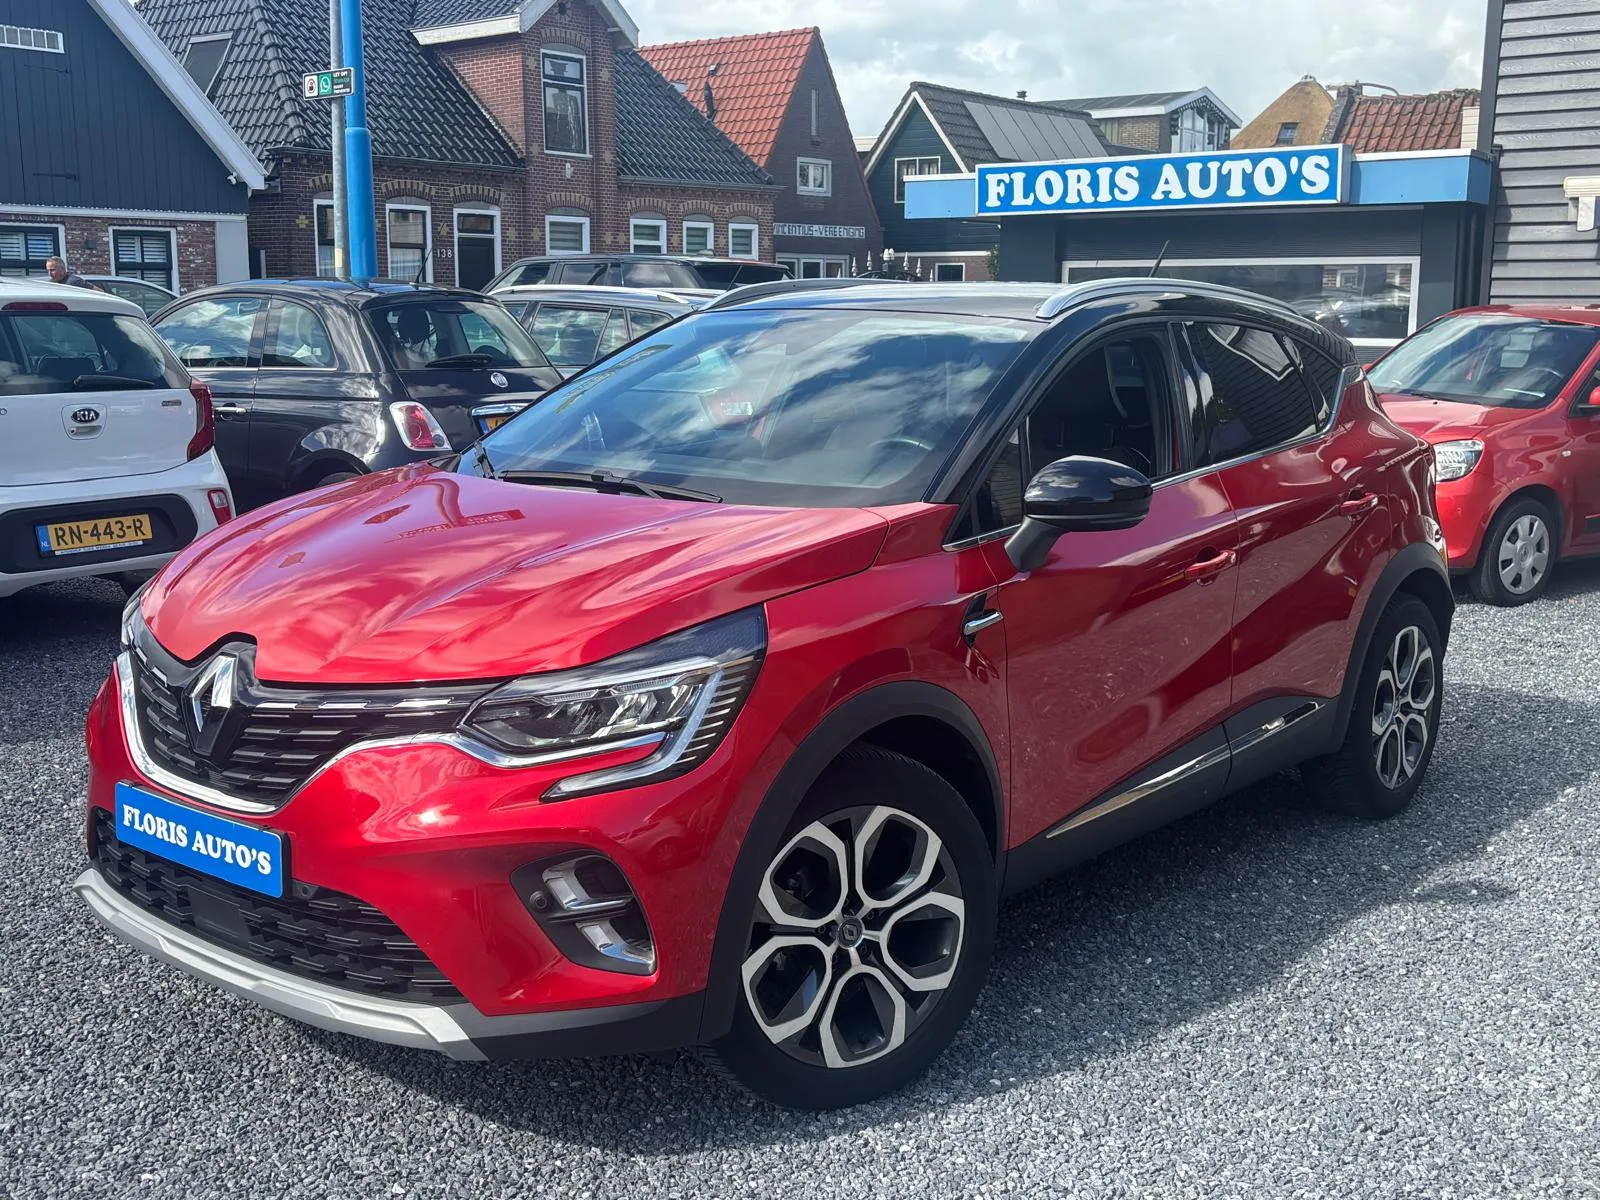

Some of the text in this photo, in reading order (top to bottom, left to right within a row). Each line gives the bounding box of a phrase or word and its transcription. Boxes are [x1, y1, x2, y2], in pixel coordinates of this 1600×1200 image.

[985, 154, 1330, 207] FLORIS AUTO'S
[437, 248, 453, 258] 138
[76, 410, 96, 421] KIA
[41, 540, 50, 548] NL
[54, 518, 146, 547] RN-443-R
[122, 804, 272, 875] FLORIS AUTO'S
